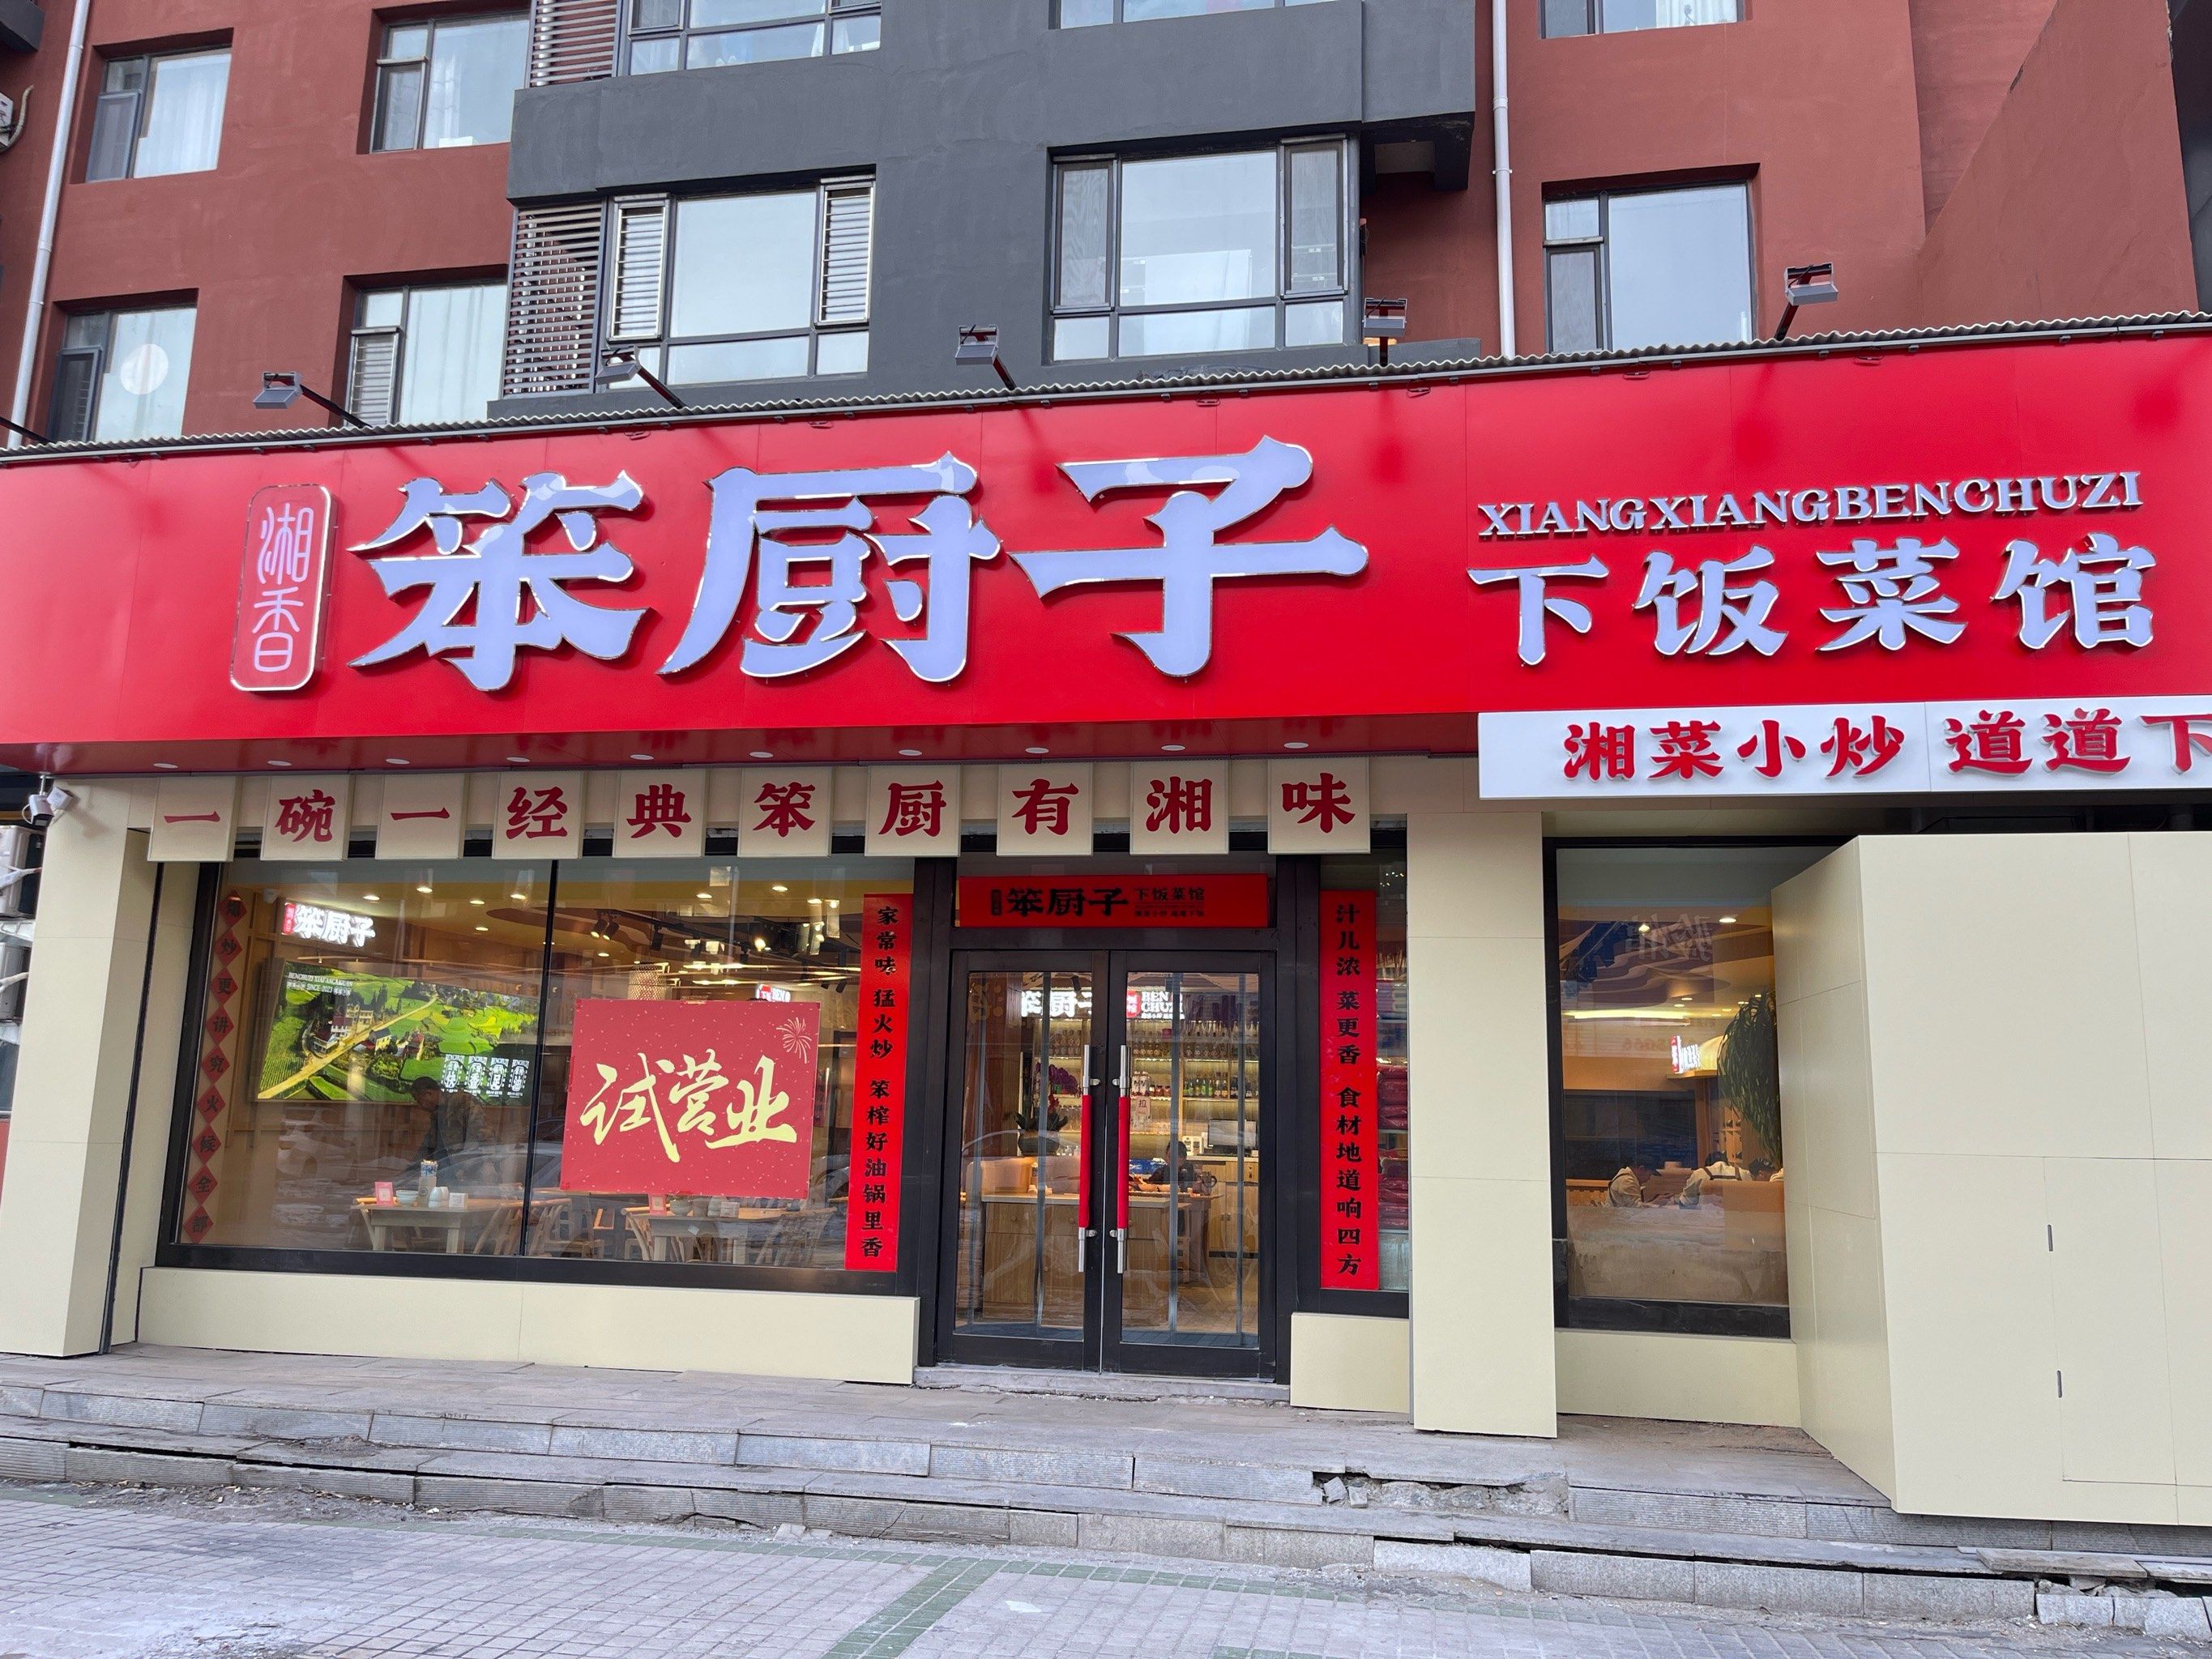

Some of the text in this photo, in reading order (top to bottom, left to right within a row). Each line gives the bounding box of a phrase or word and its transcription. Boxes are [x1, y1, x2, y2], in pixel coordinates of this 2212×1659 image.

[1477, 471, 2143, 539] XIANGXIANGBENCHUZI
[251, 505, 314, 673] 湘香
[347, 434, 1369, 691] 笨厨子
[1467, 533, 2157, 666] 下饭菜馆
[1563, 710, 2212, 783] 湘菜小炒 道道下
[164, 772, 1356, 842] 一碗一经典笨厨有湘味
[293, 905, 376, 946] 笨厨子
[1006, 887, 1129, 918] 笨厨子
[1142, 991, 1168, 1002] BEN
[580, 1048, 797, 1163] 试营业
[861, 906, 899, 1258] 家常味 猛火炒 笨榨好油锅里香
[1335, 903, 1363, 1276] 汁儿浓 菜更香 食材地道响四方
